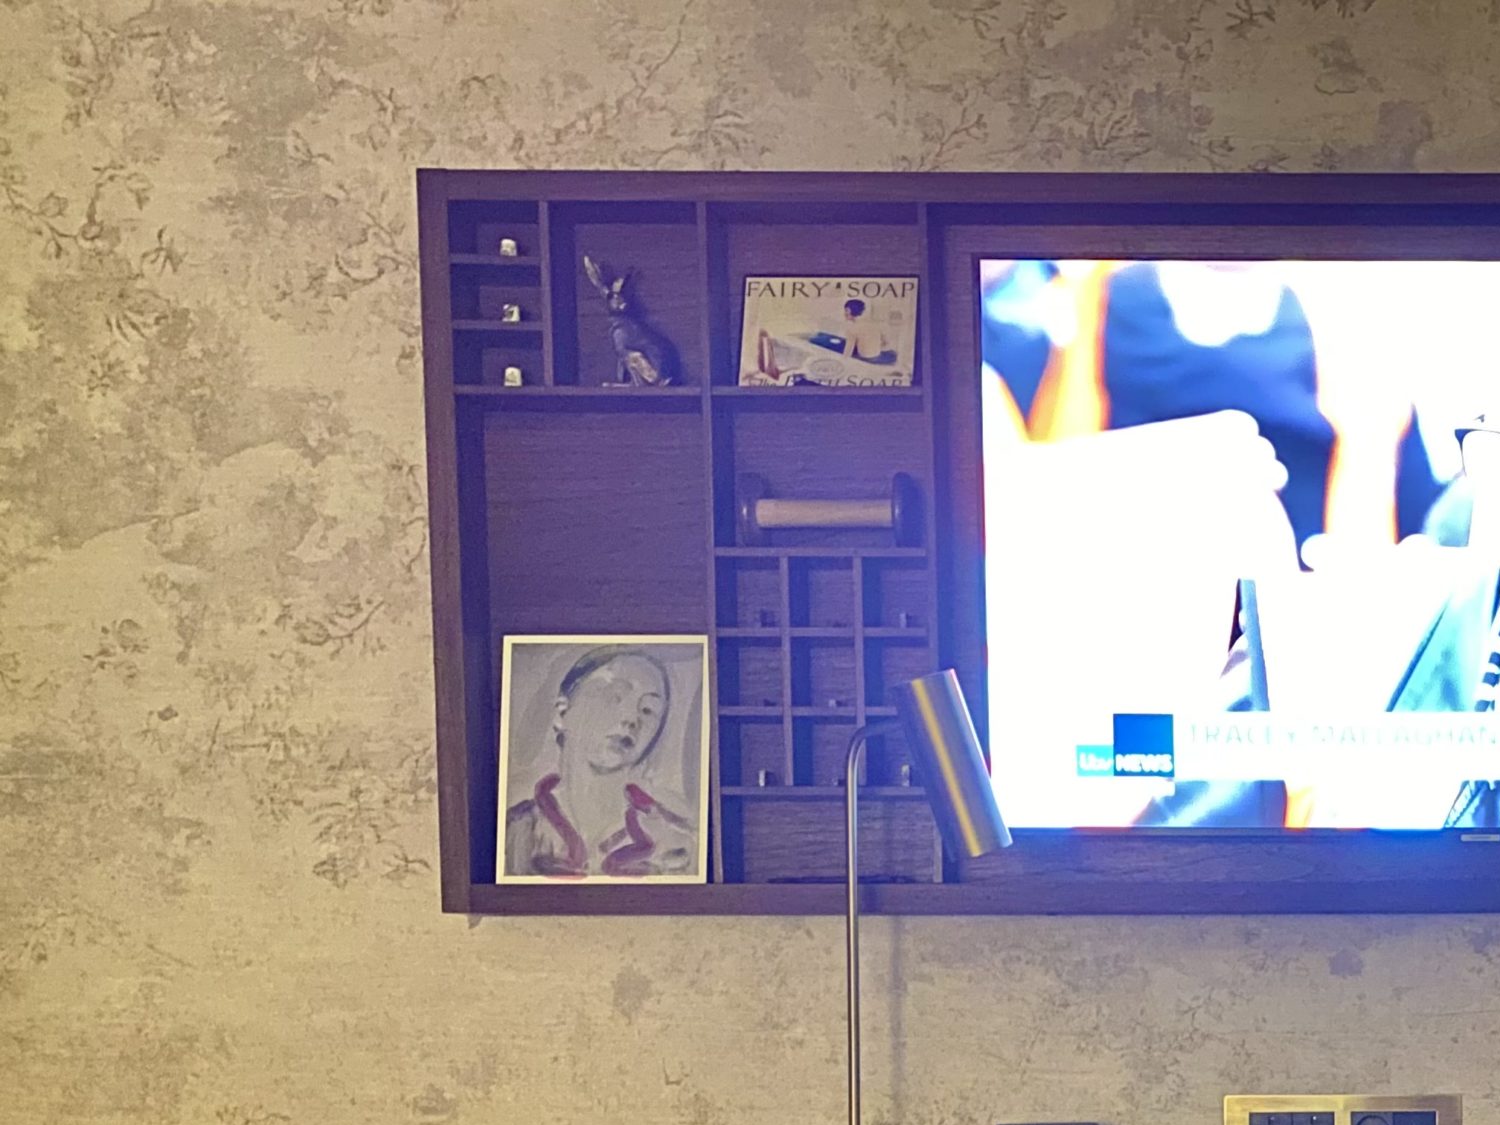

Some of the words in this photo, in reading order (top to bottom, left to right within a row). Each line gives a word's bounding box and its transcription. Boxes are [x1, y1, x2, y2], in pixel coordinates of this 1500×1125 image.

[747, 281, 829, 298] FAIRY
[847, 281, 915, 298] SOAP
[1115, 753, 1173, 772] NEWS
